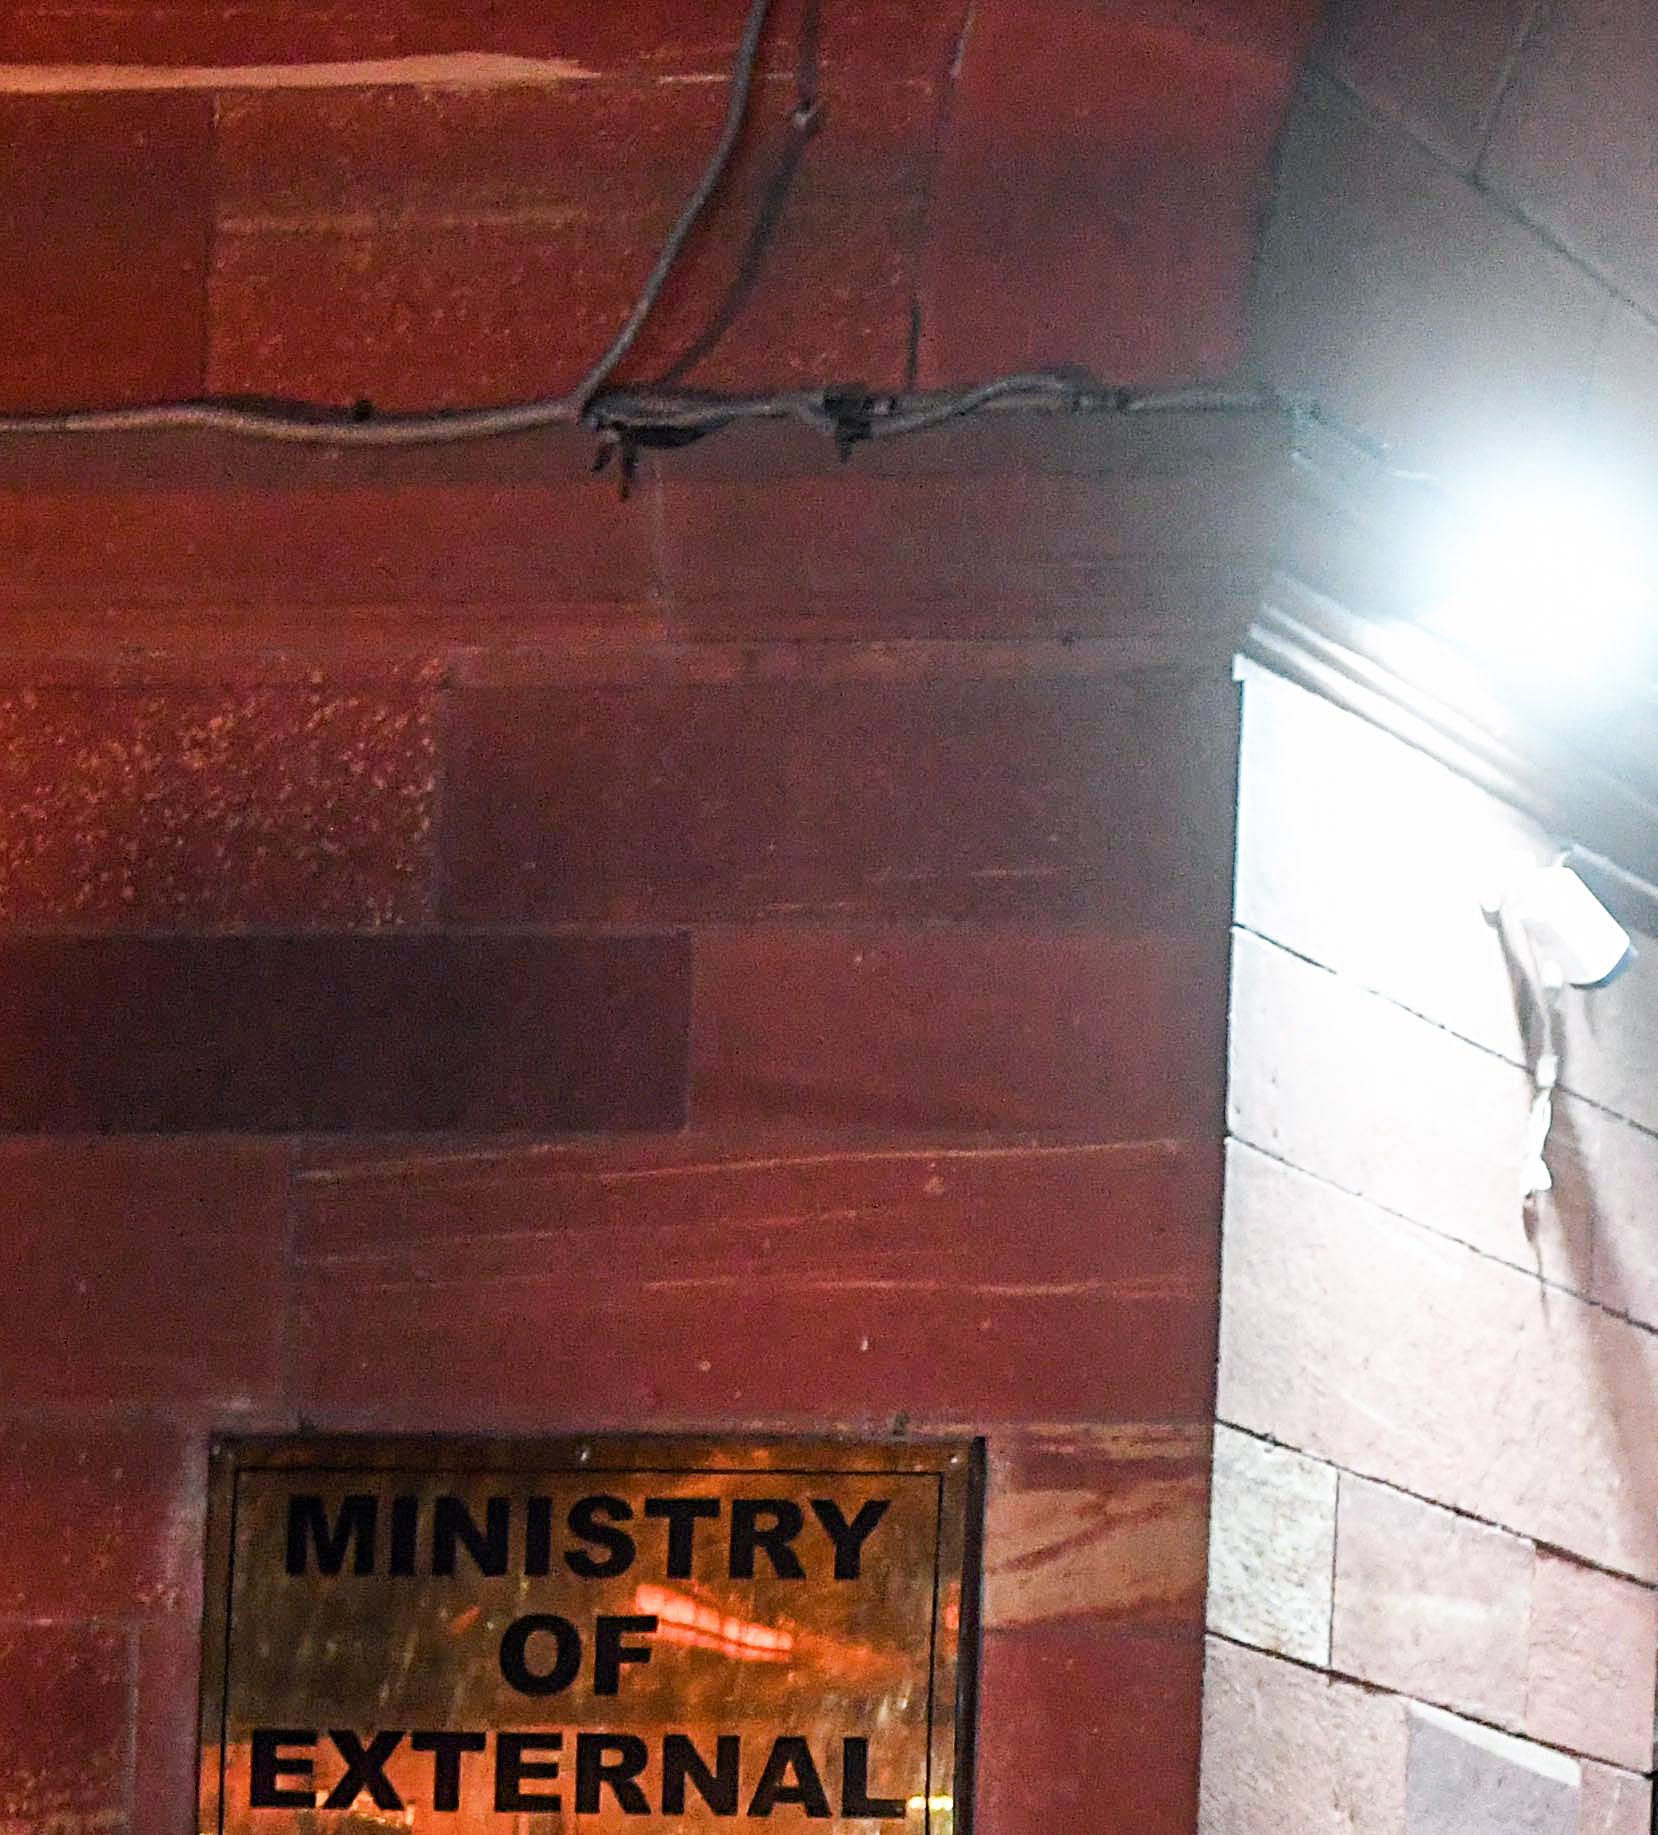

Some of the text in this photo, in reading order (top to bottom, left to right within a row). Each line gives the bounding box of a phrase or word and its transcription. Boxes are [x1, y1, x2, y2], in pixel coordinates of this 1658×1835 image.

[285, 1495, 892, 1580] MINISTRY
[499, 1614, 658, 1696] OF
[250, 1729, 906, 1819] EXTERNAL
